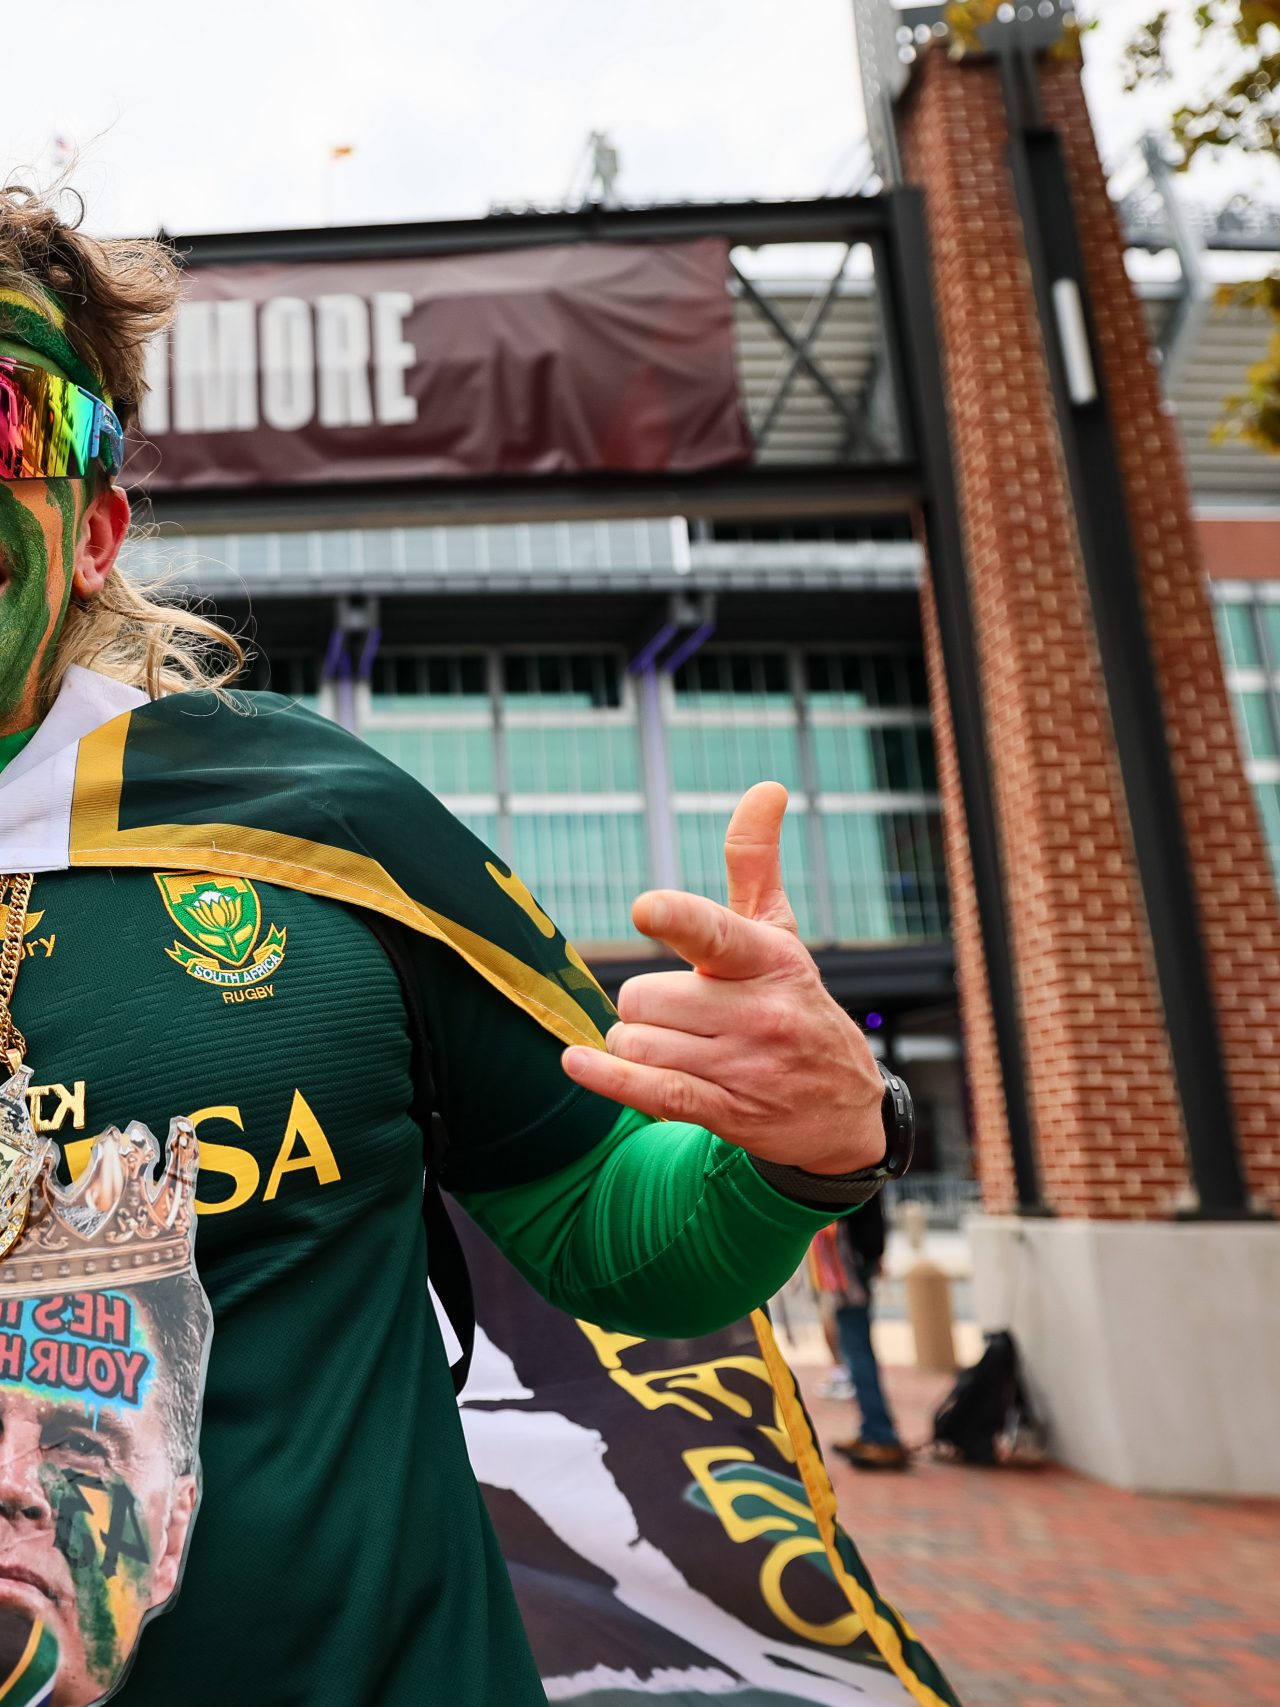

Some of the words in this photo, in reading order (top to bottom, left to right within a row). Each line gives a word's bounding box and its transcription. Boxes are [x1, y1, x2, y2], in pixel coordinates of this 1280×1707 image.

[141, 291, 418, 435] IMORE
[193, 964, 240, 983] SOUTH
[243, 953, 282, 983] AFRICA
[222, 984, 274, 1004] RUGBY
